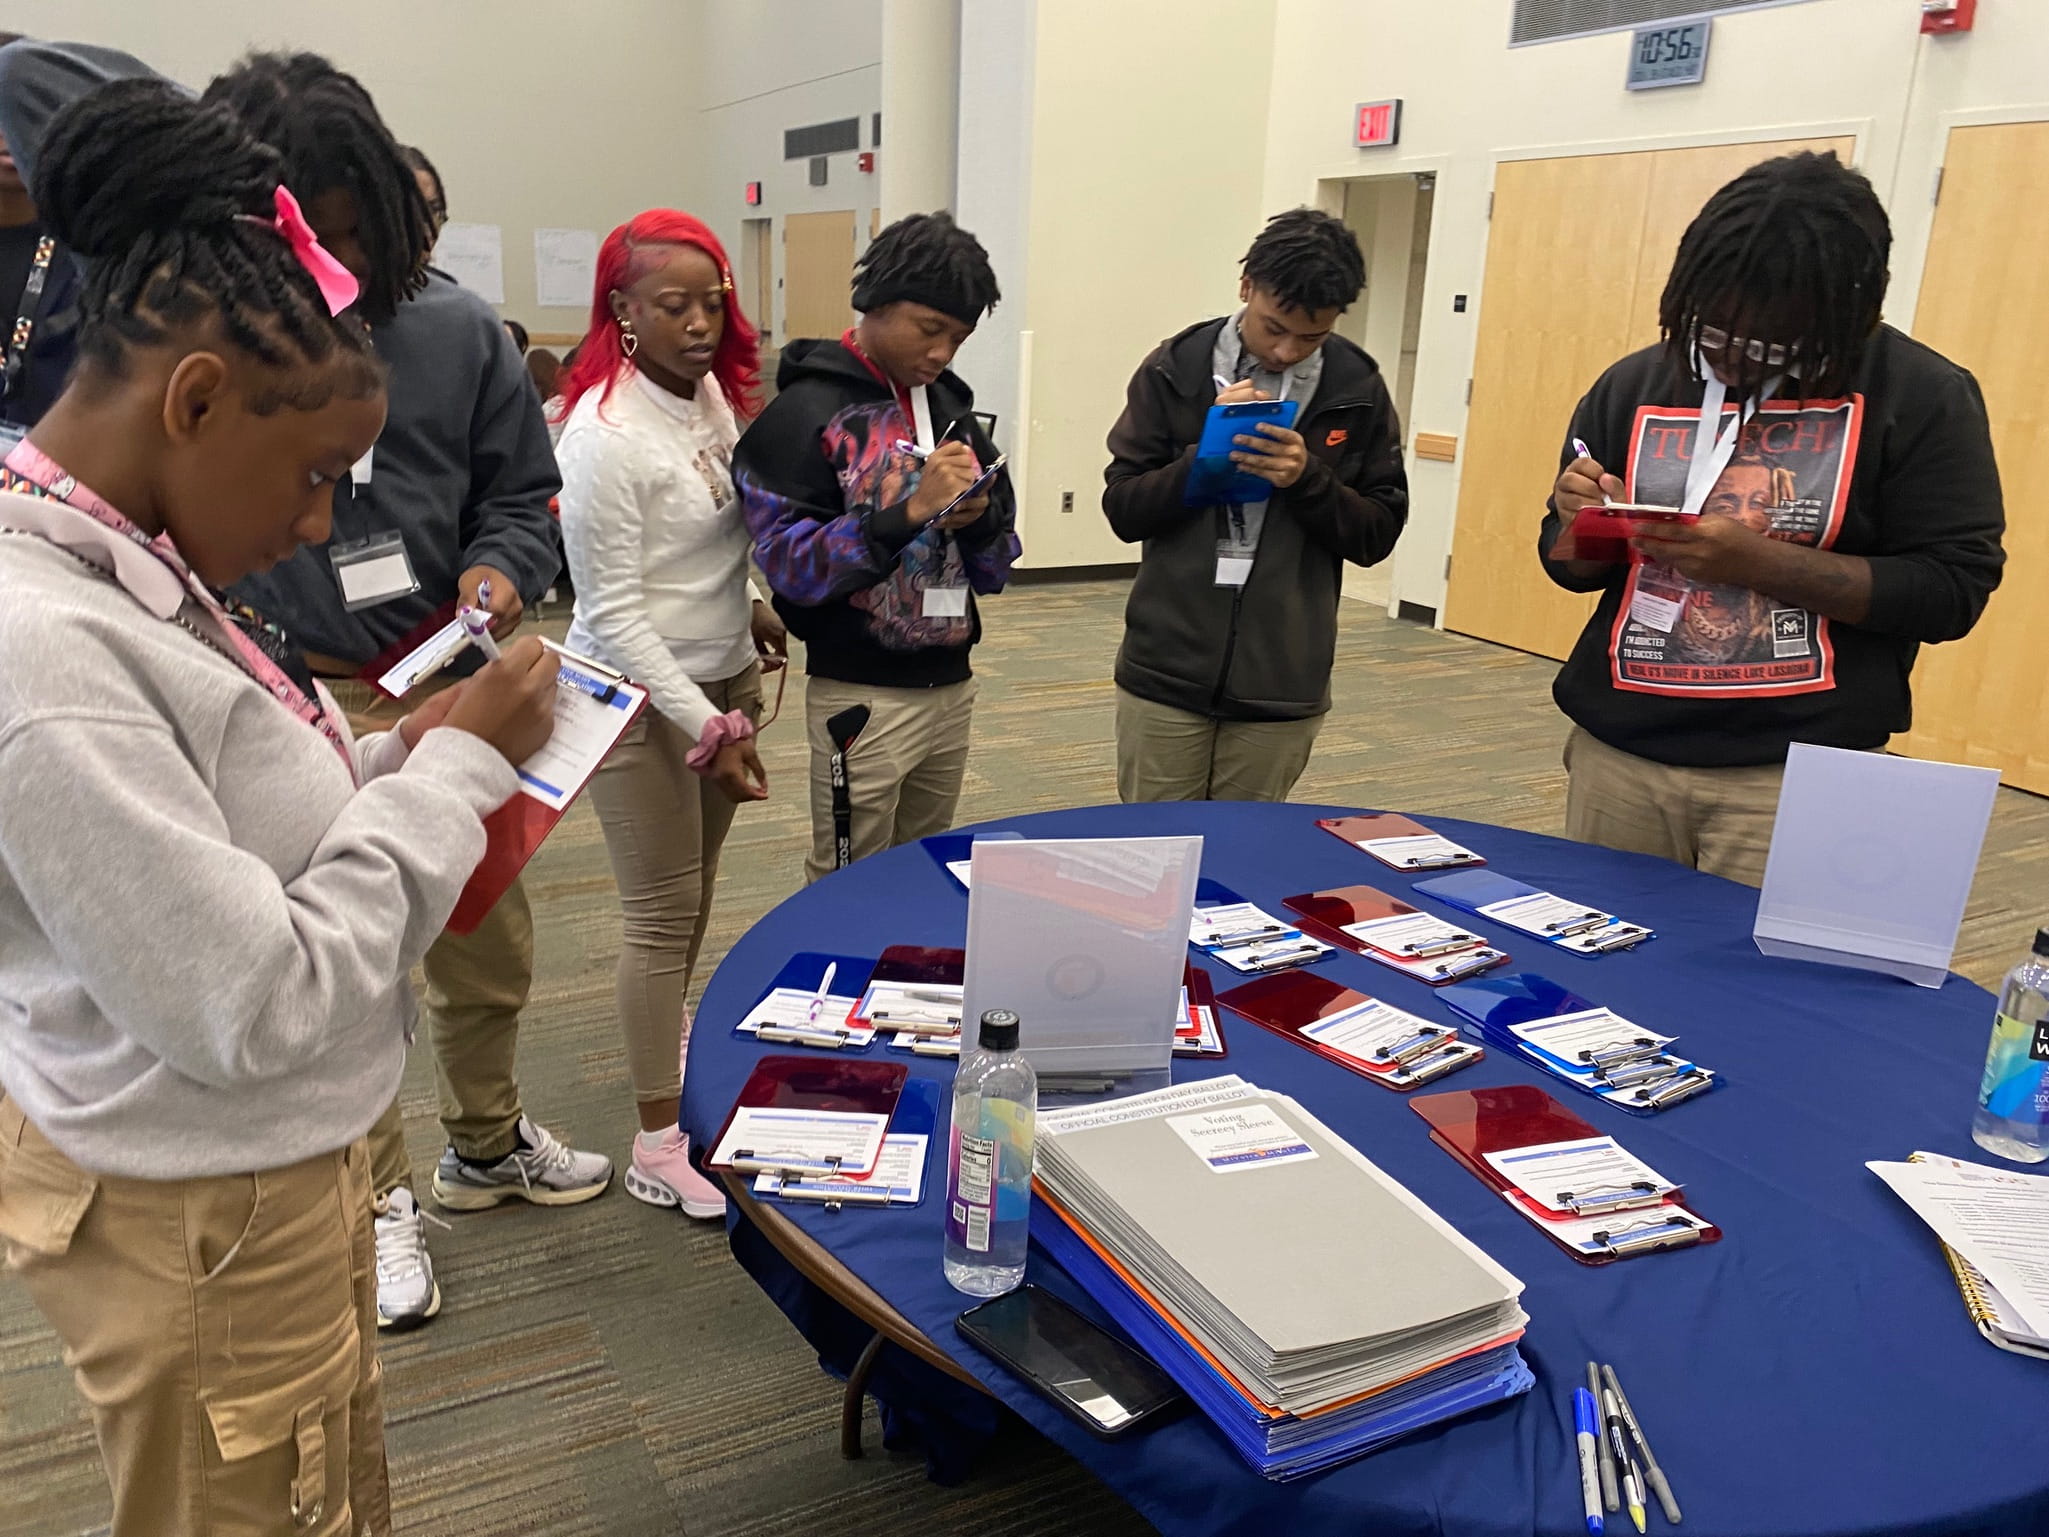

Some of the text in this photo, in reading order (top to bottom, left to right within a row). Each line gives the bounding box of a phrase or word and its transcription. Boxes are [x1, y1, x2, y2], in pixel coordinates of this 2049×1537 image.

[1637, 27, 1693, 64] 10:56
[1359, 104, 1391, 142] EXIT
[1060, 1088, 1247, 1130] OFFICIAL CONSTITUTION DAY BALLOT
[1203, 1113, 1244, 1125] Voting
[1190, 1119, 1274, 1138] Secrecy Sleeve
